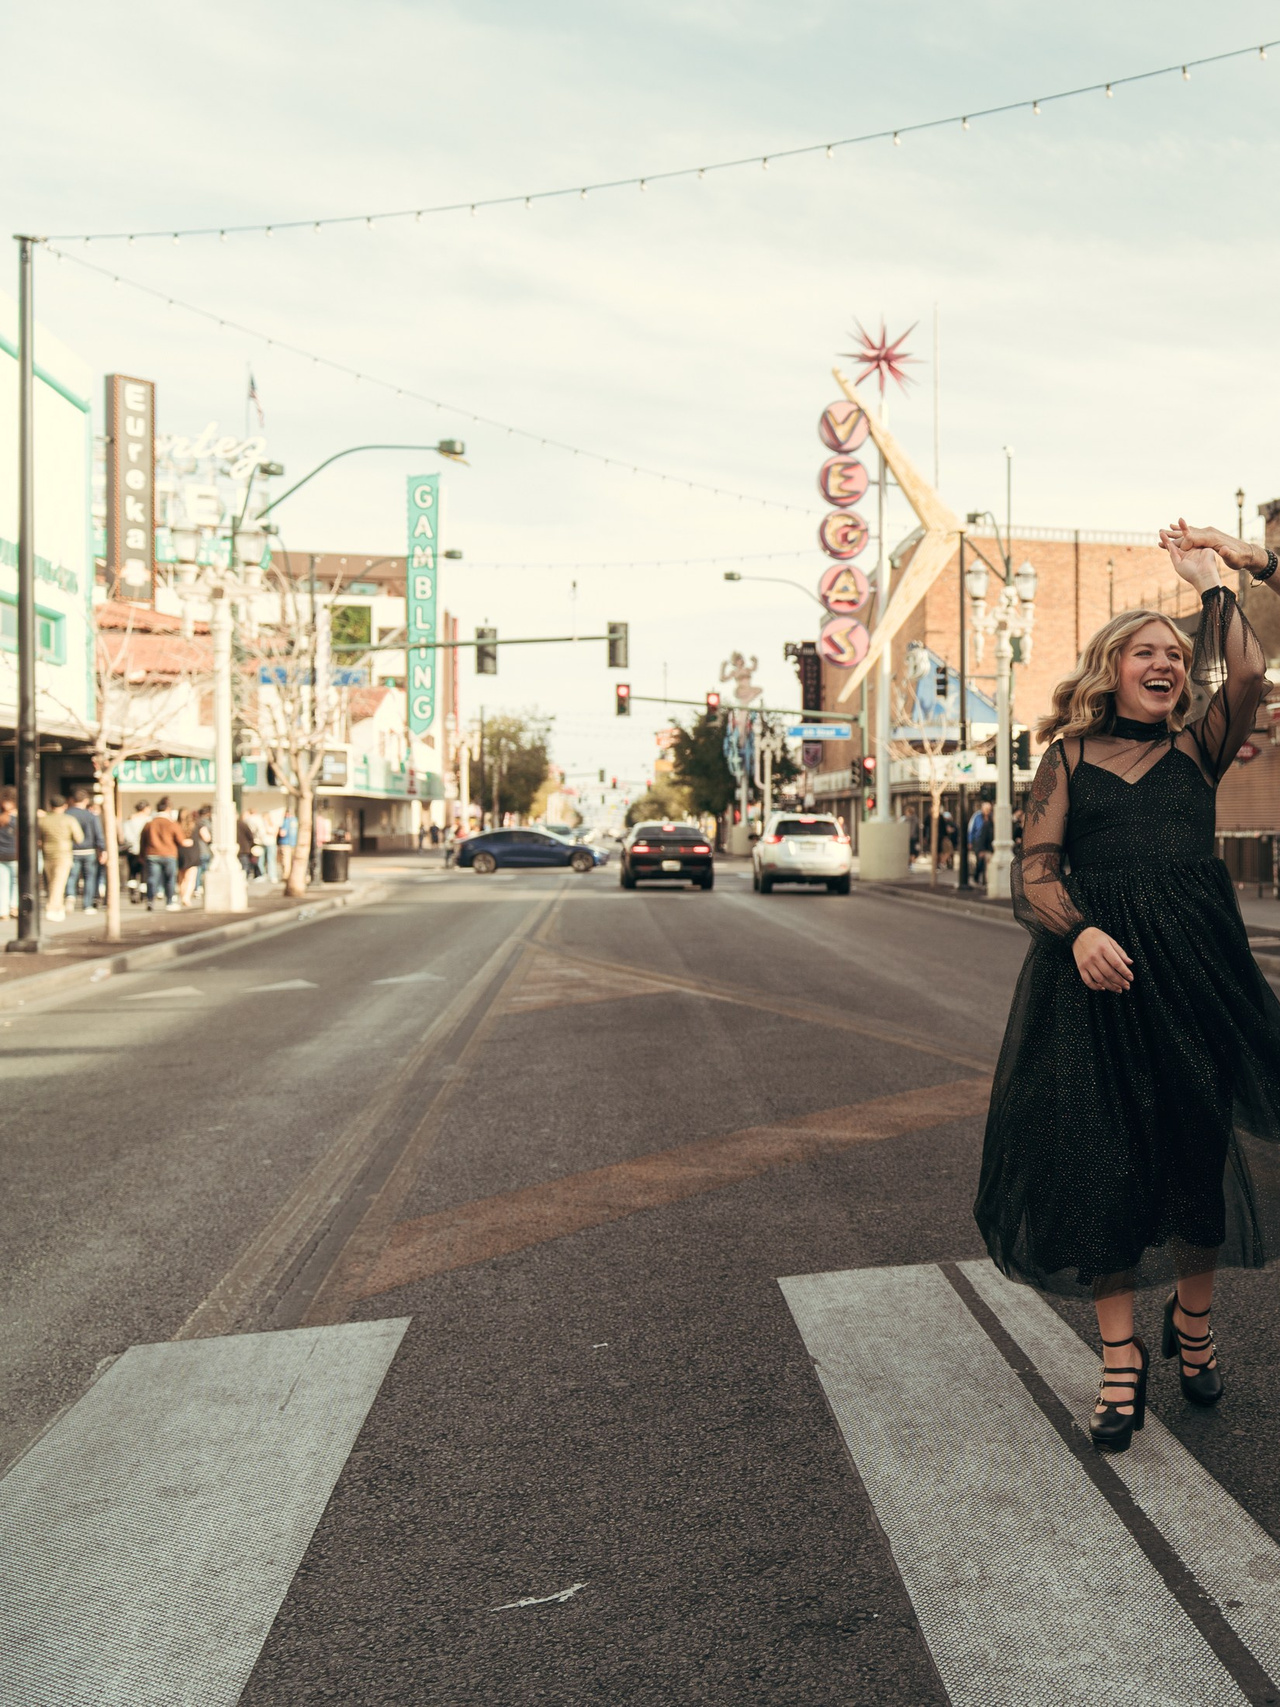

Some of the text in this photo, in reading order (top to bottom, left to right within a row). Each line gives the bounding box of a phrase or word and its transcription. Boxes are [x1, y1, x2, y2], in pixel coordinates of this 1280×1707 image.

[124, 383, 147, 550] Eureka
[820, 404, 869, 667] VEGAS
[412, 484, 435, 720] GAMBLING
